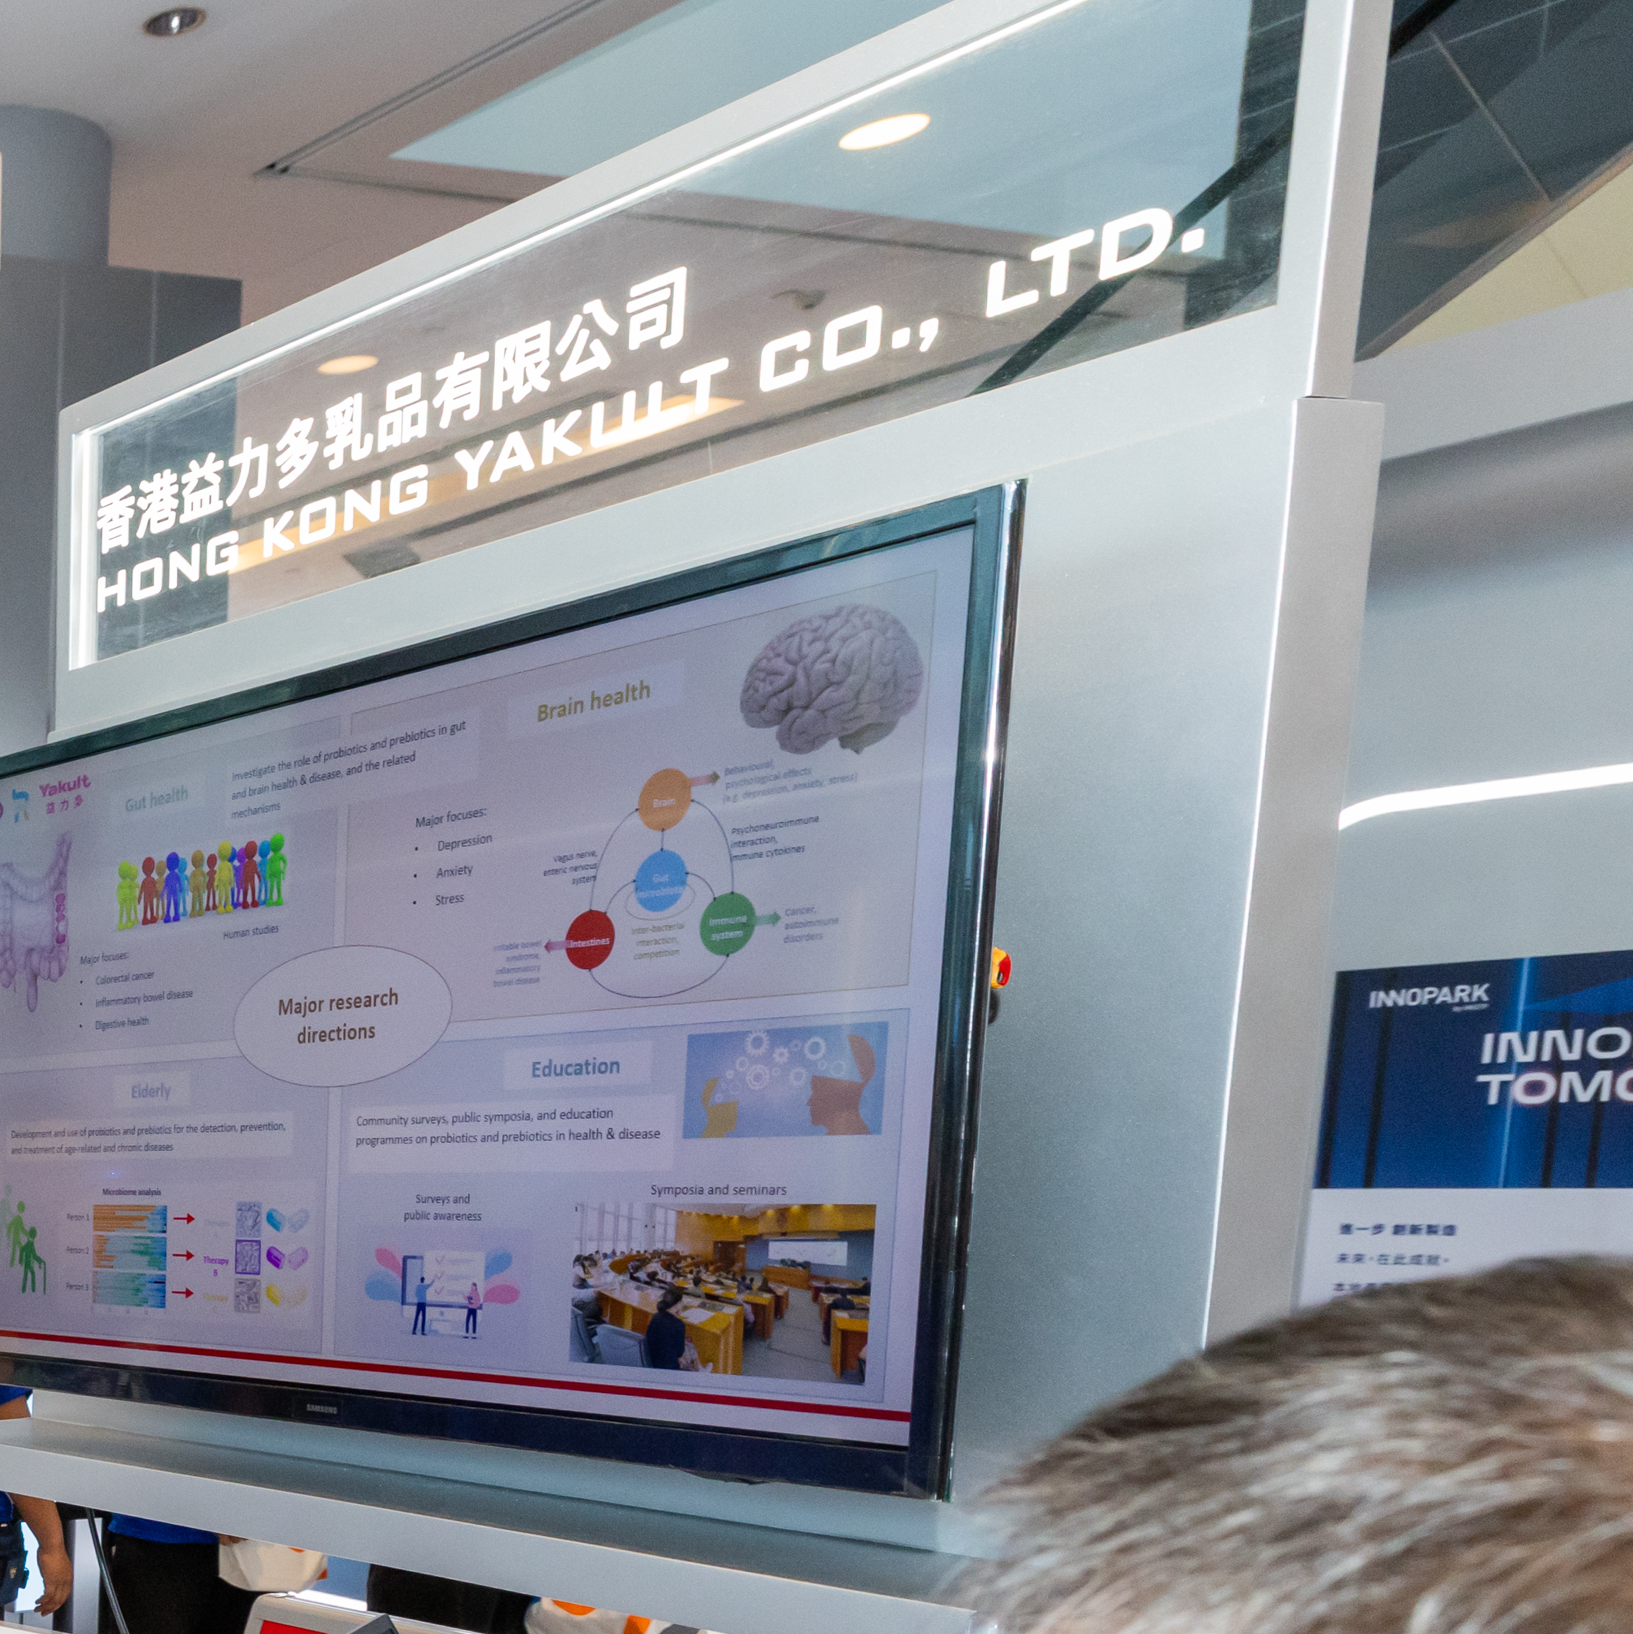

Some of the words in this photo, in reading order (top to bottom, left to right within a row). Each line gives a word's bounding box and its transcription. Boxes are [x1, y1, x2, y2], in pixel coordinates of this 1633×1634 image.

[95, 266, 689, 557] 香港益力多乳品有限公司
[98, 533, 239, 614] HONG
[264, 468, 431, 558] KONG
[454, 356, 730, 495] YAKULT
[760, 304, 940, 394] CO.,
[987, 207, 1207, 318] LTD.
[536, 697, 585, 723] Brain
[589, 681, 651, 711] health
[278, 759, 293, 771] the
[293, 755, 311, 768] role
[324, 743, 368, 763] probiotics
[370, 737, 387, 751] and
[438, 724, 447, 735] in
[449, 720, 467, 737] gut
[365, 759, 380, 772] the
[382, 750, 416, 768] related
[39, 774, 92, 798] Yakult
[415, 814, 444, 829] Major
[437, 834, 493, 852] Depression
[436, 864, 474, 879] Anxiety
[435, 894, 465, 906] Stress
[278, 996, 325, 1018] Major
[329, 987, 399, 1012] research
[1369, 983, 1490, 1008] INNOPARK
[297, 1022, 376, 1044] directions
[1481, 1026, 1633, 1064] INNO
[532, 1056, 621, 1080] Education
[131, 1081, 172, 1102] Elderly
[356, 1114, 409, 1128] Community
[451, 1111, 481, 1126] public
[536, 1109, 557, 1121] and
[559, 1107, 613, 1120] education
[356, 1134, 413, 1148] programmes
[415, 1134, 428, 1144] on
[430, 1131, 478, 1145] probiotics
[480, 1130, 500, 1143] and
[501, 1129, 553, 1145] prebiotics
[555, 1129, 566, 1140] in
[568, 1127, 603, 1141] health
[606, 1127, 615, 1140] &
[618, 1127, 661, 1140] disease
[415, 1193, 451, 1207] Surveys
[453, 1193, 471, 1205] and
[651, 1183, 705, 1199] Symposia
[708, 1183, 729, 1196] and
[732, 1183, 787, 1197] seminars
[404, 1209, 431, 1223] public
[433, 1210, 482, 1221] awareness
